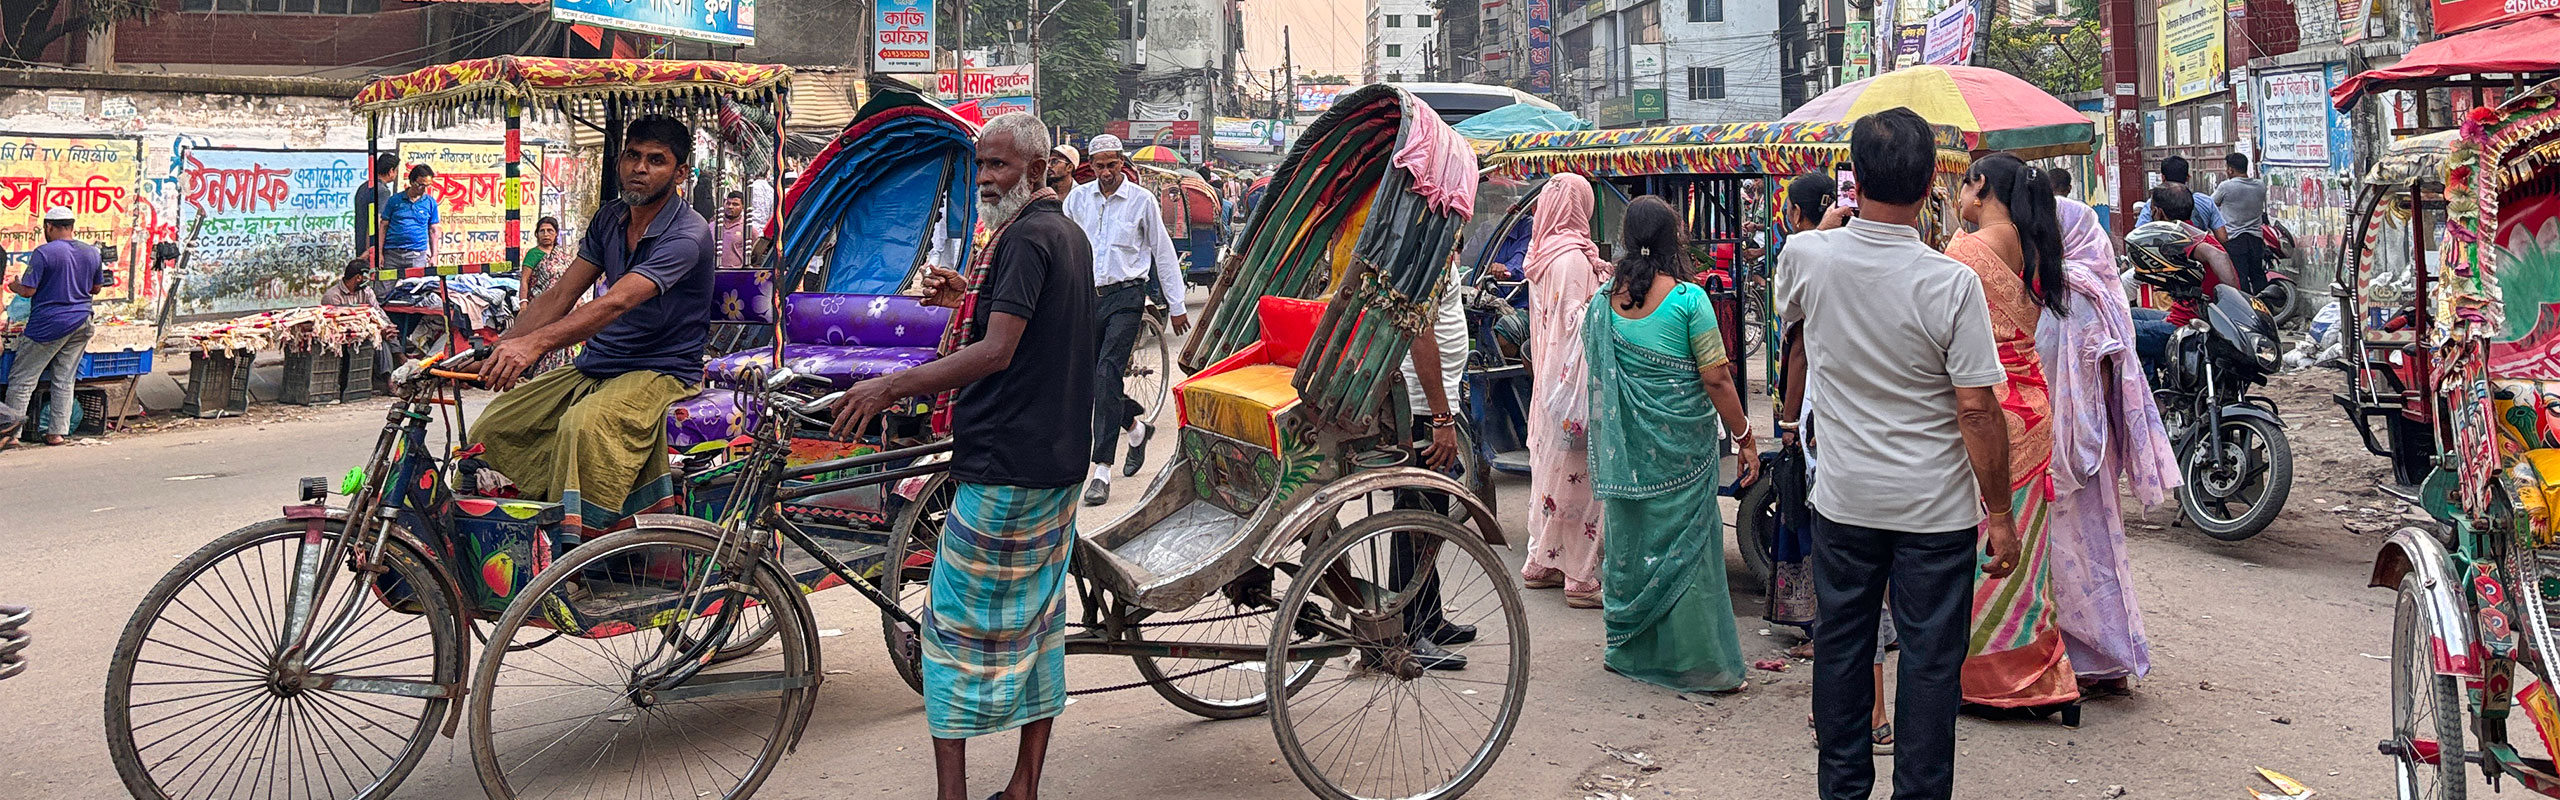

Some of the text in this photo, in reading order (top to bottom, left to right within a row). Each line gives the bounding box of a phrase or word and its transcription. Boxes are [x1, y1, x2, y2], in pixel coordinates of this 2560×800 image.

[884, 8, 925, 25] কাজি
[879, 26, 928, 44] অফিস
[938, 73, 1029, 95] আমান হোটেল
[2272, 77, 2285, 96] ভর্তি
[42, 148, 62, 161] TV
[185, 152, 356, 216] ইনসাফ একাডেমিক
[43, 175, 125, 214] কোচিং
[291, 189, 350, 210] এডমিশন
[302, 213, 338, 234] (সকল
[73, 226, 114, 241] পাঠদান
[190, 234, 251, 249] SC-2024
[466, 231, 500, 243] সকল
